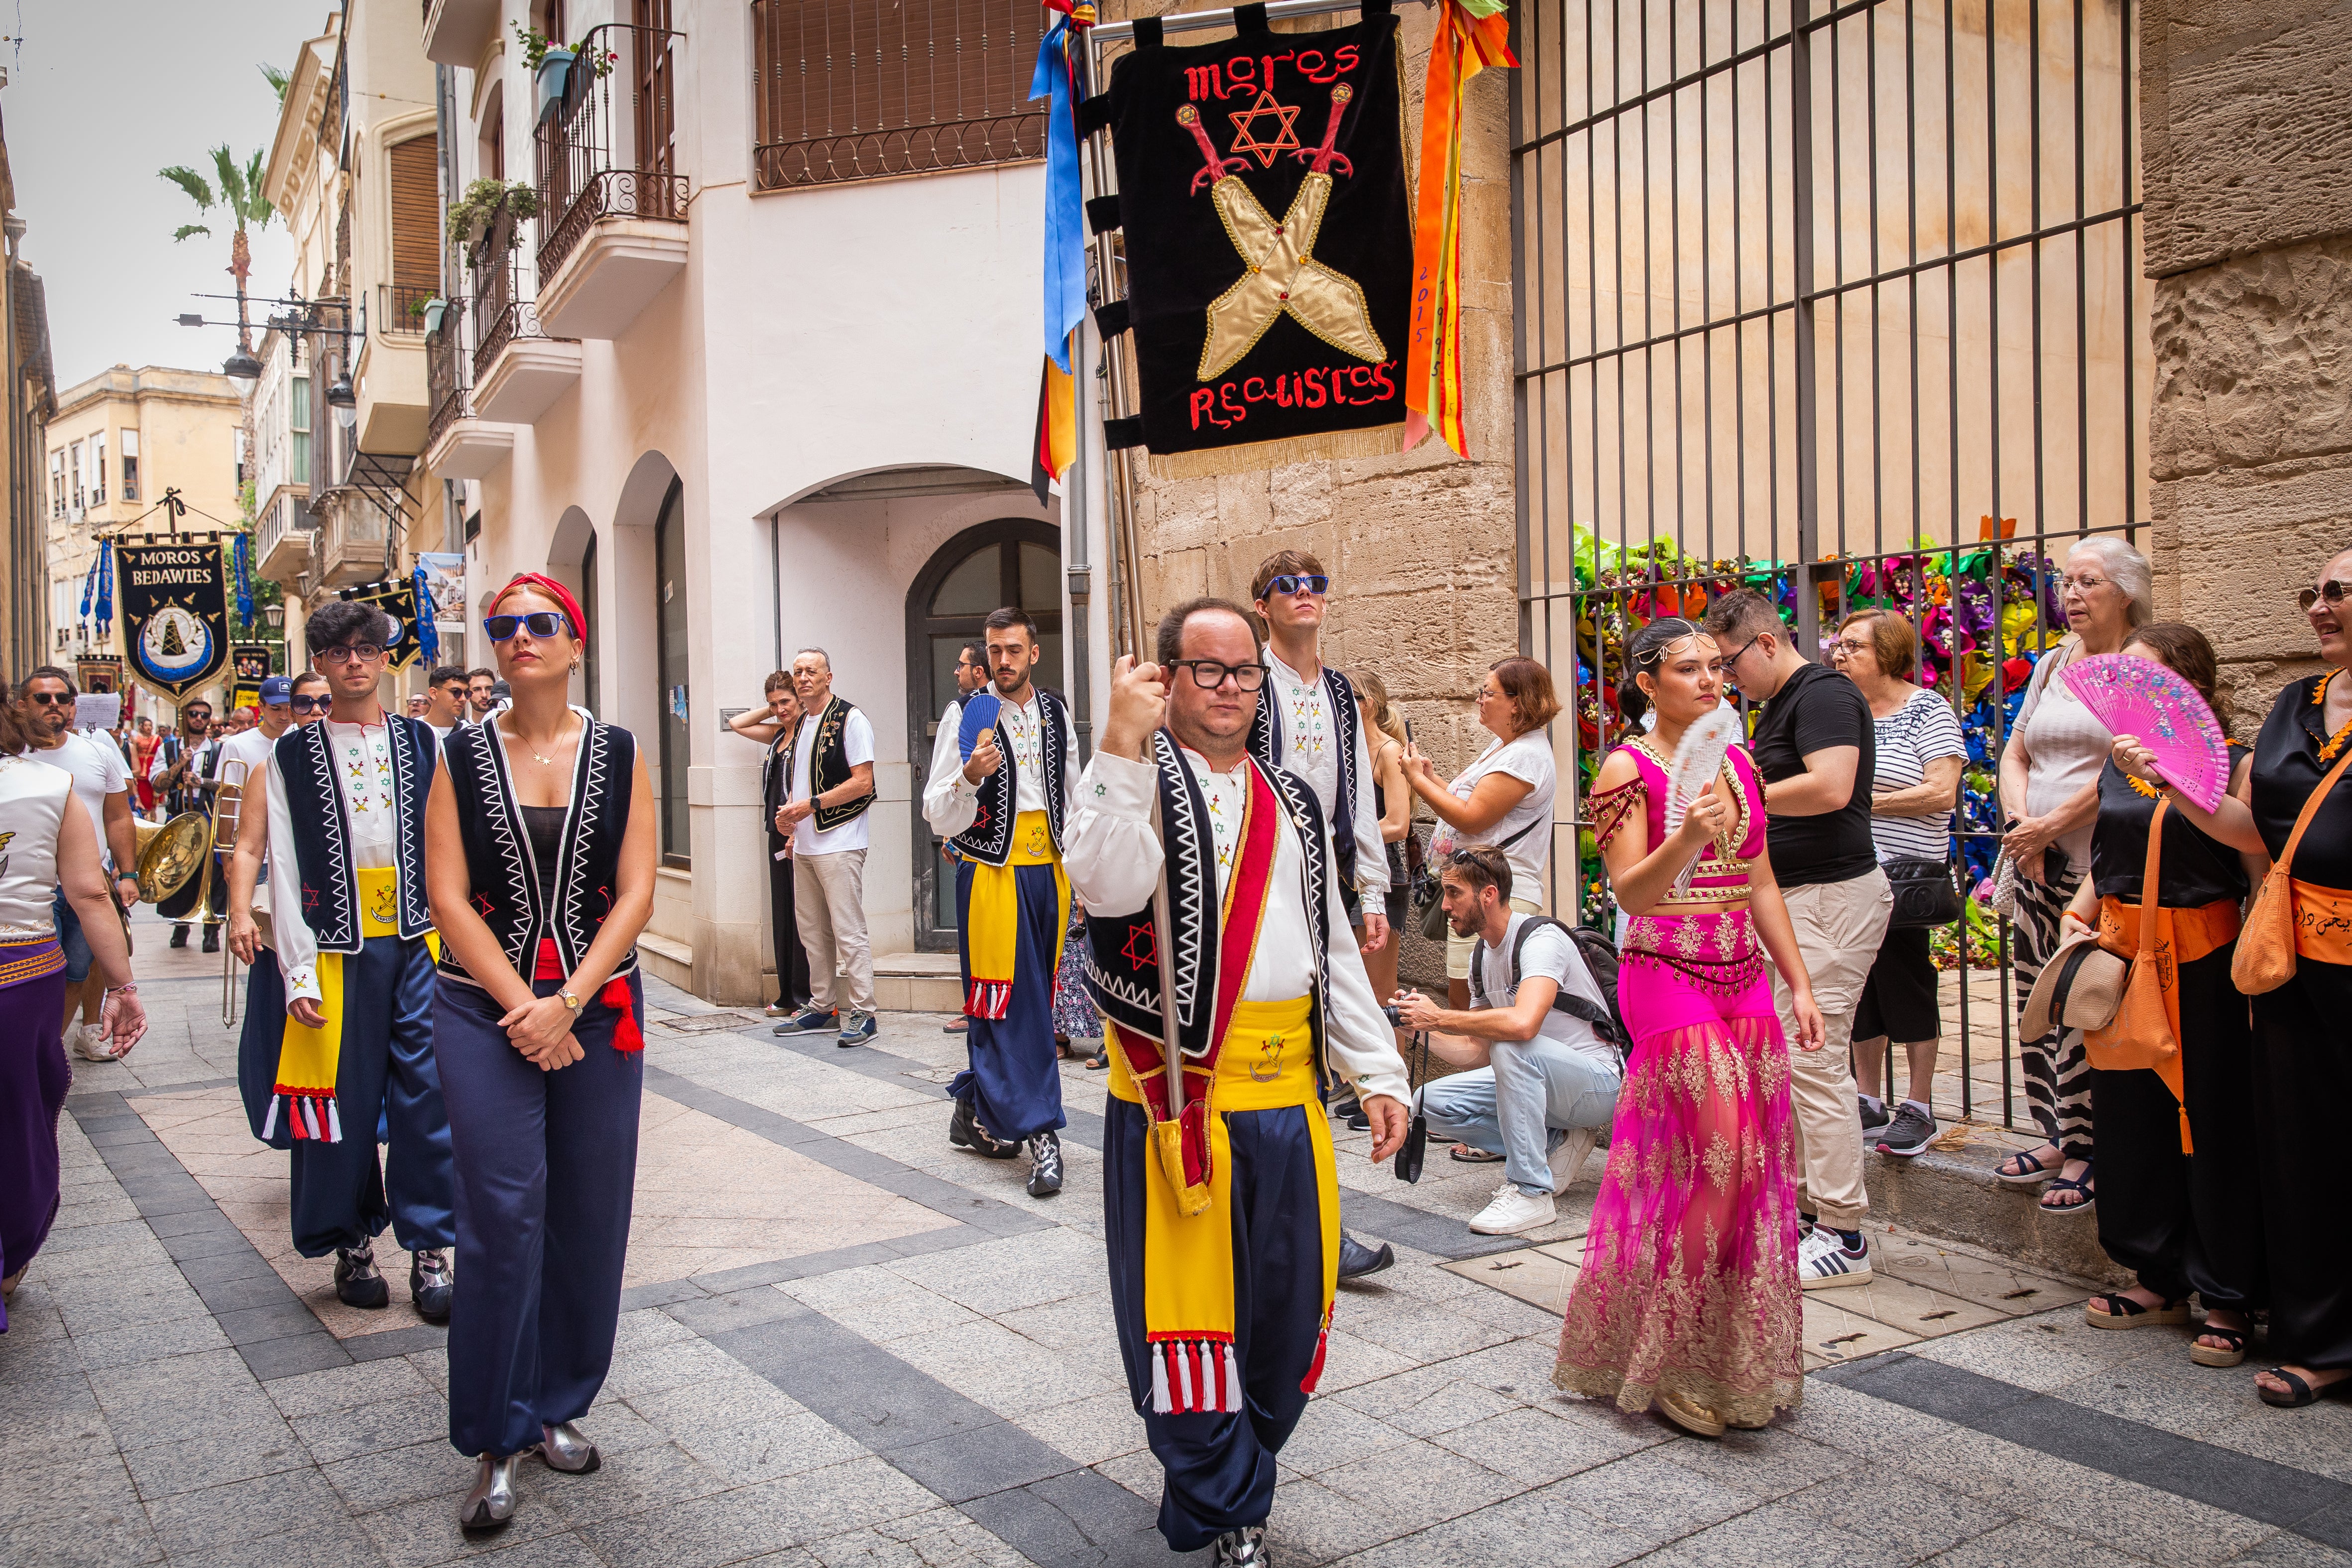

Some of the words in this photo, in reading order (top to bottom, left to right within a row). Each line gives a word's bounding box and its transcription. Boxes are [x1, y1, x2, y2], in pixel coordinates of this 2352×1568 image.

[1416, 266, 1428, 343] 2015
[1431, 278, 1445, 377] 1995
[140, 550, 201, 566] MOROS
[132, 568, 213, 586] BEDAWIES
[1813, 1231, 1829, 1241] adidas
